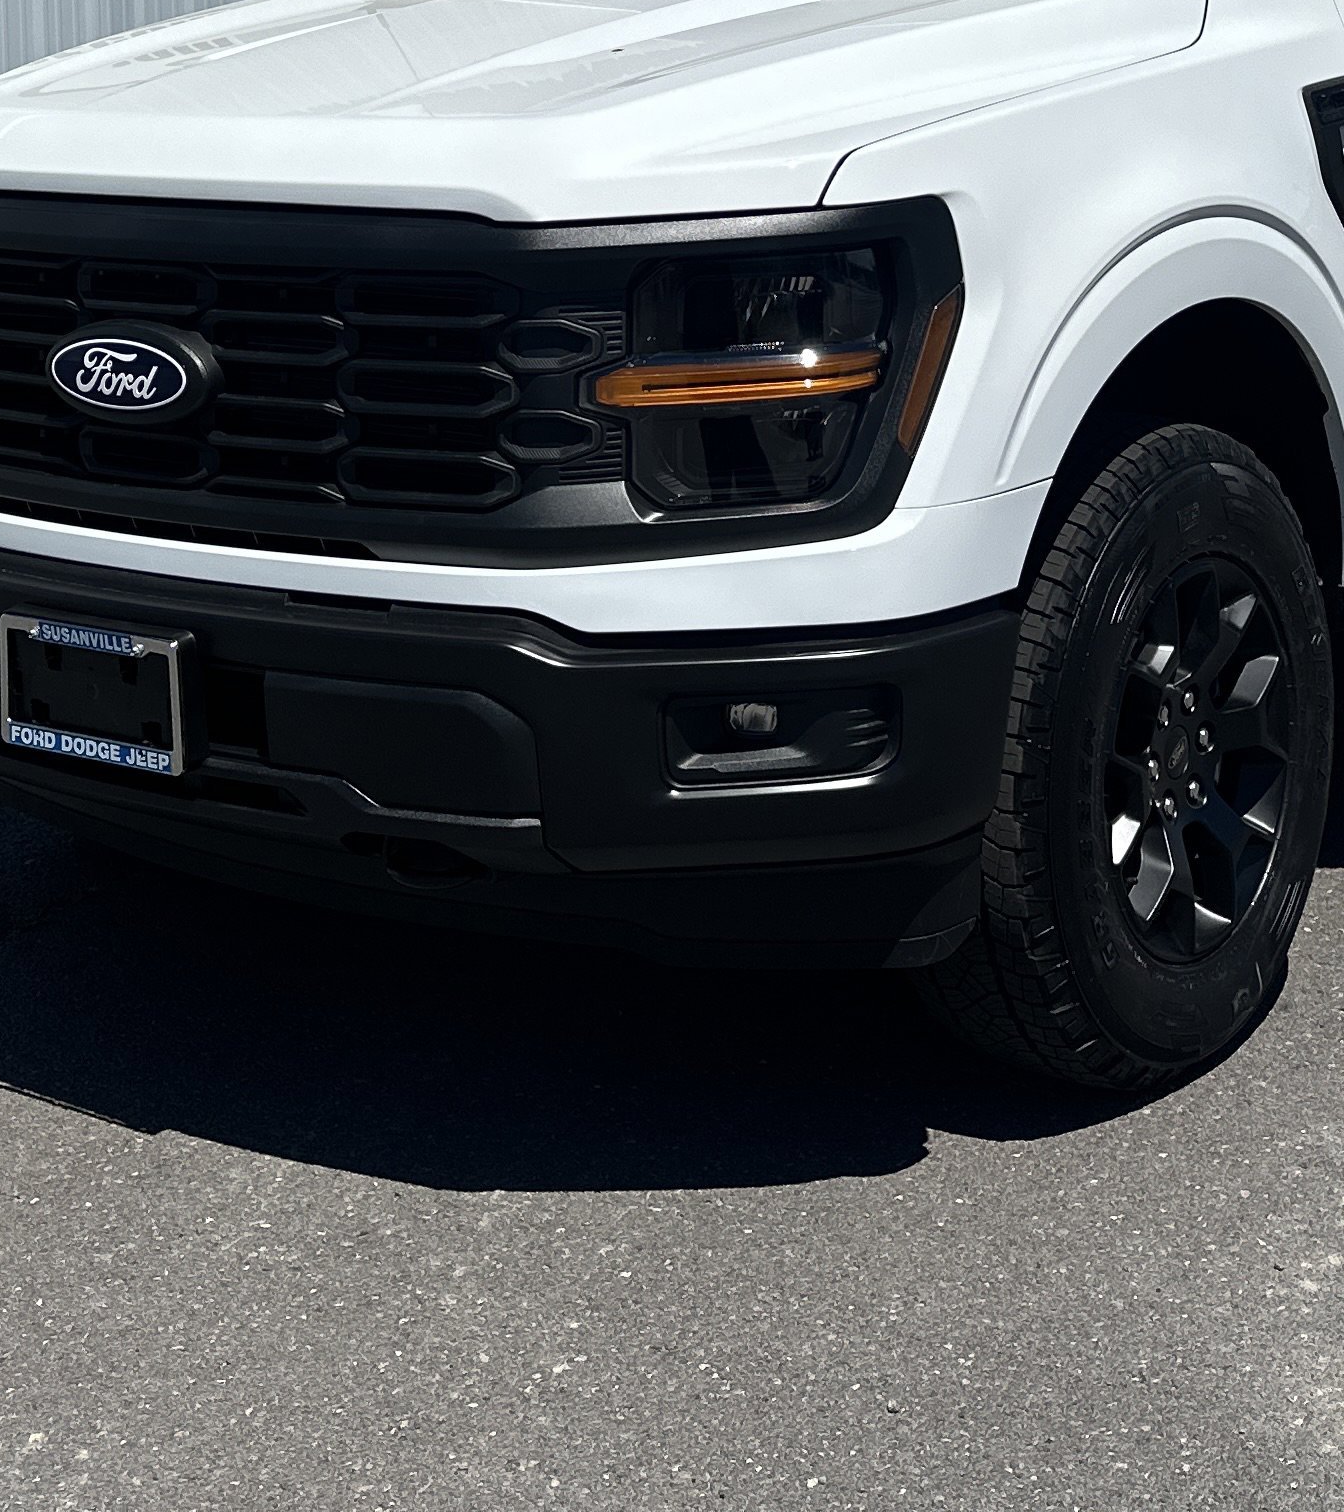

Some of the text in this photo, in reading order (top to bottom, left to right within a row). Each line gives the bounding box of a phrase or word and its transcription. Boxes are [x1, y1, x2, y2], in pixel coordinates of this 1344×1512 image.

[75, 347, 159, 400] Ford
[42, 624, 132, 654] SUSANVILLE
[10, 725, 171, 772] FORD DODGE JEEP
